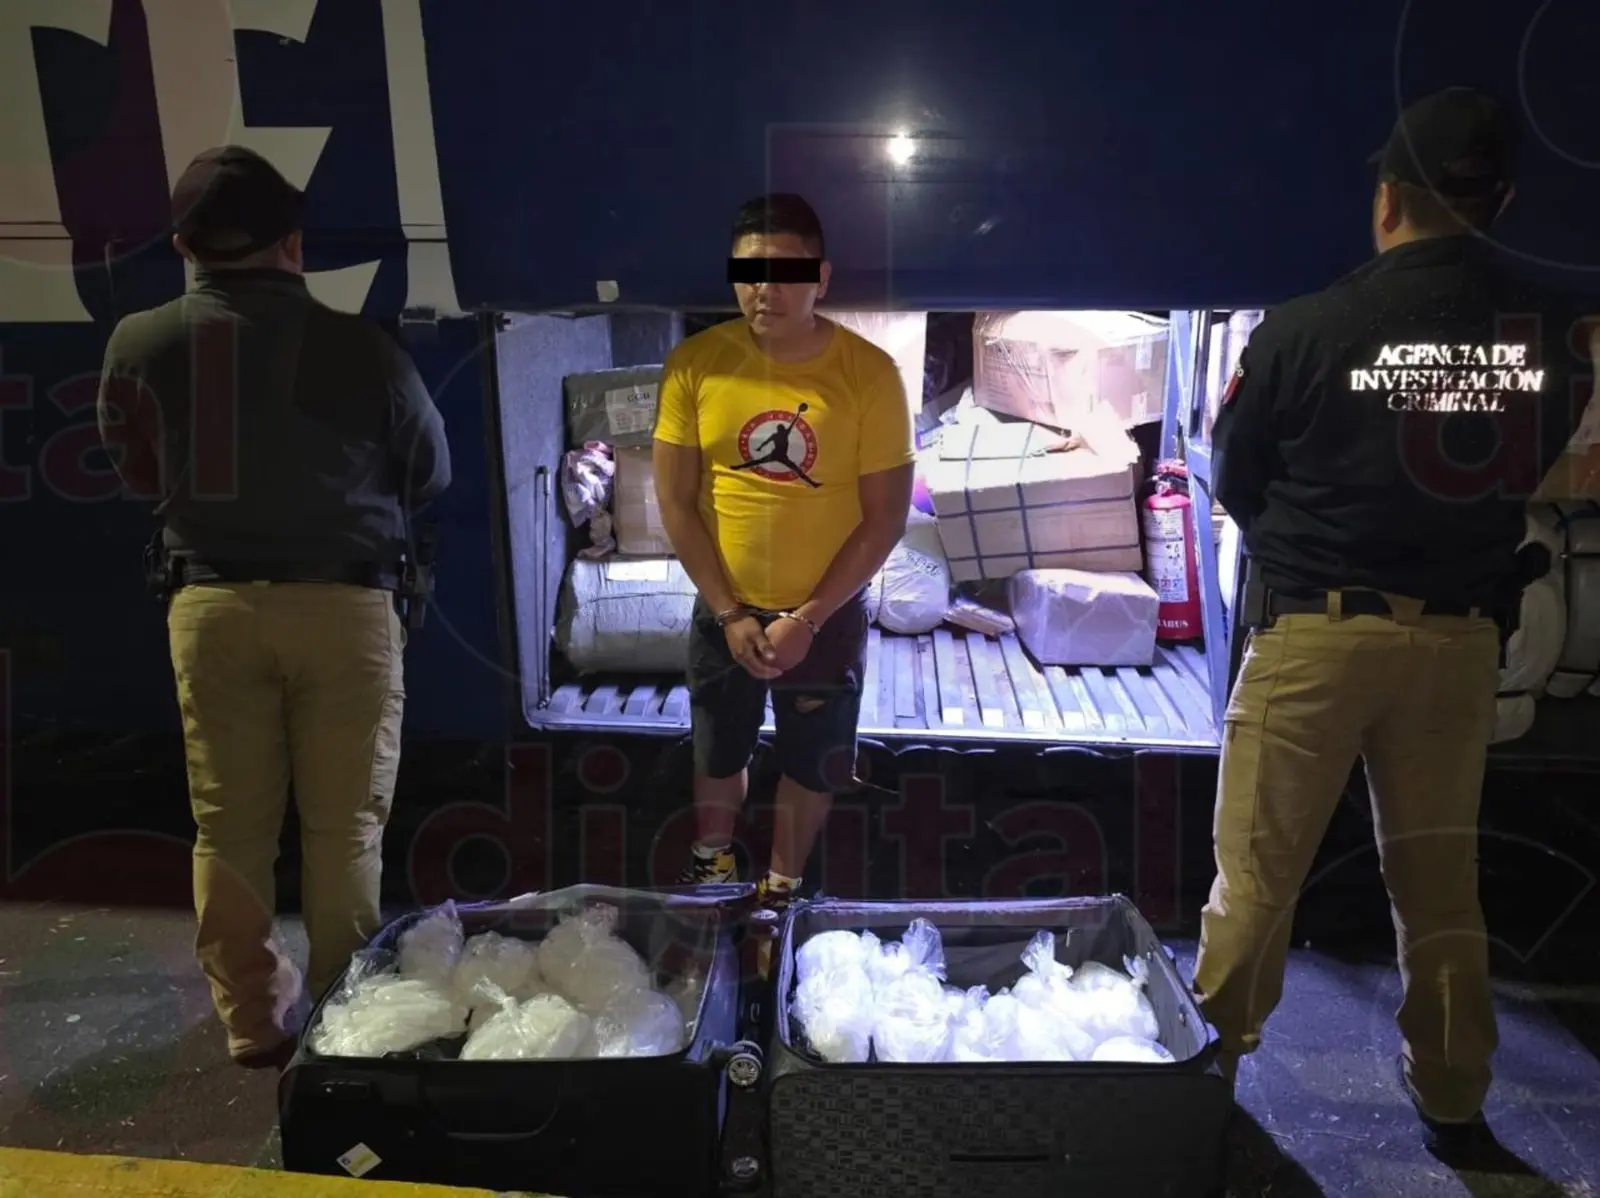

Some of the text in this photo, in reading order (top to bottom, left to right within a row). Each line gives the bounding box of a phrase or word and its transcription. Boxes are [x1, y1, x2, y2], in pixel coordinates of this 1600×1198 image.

[1374, 343, 1526, 366] AGENCIA DE
[1351, 367, 1544, 391] INVESTIGACIÓN
[1387, 391, 1505, 412] CRIMINAL
